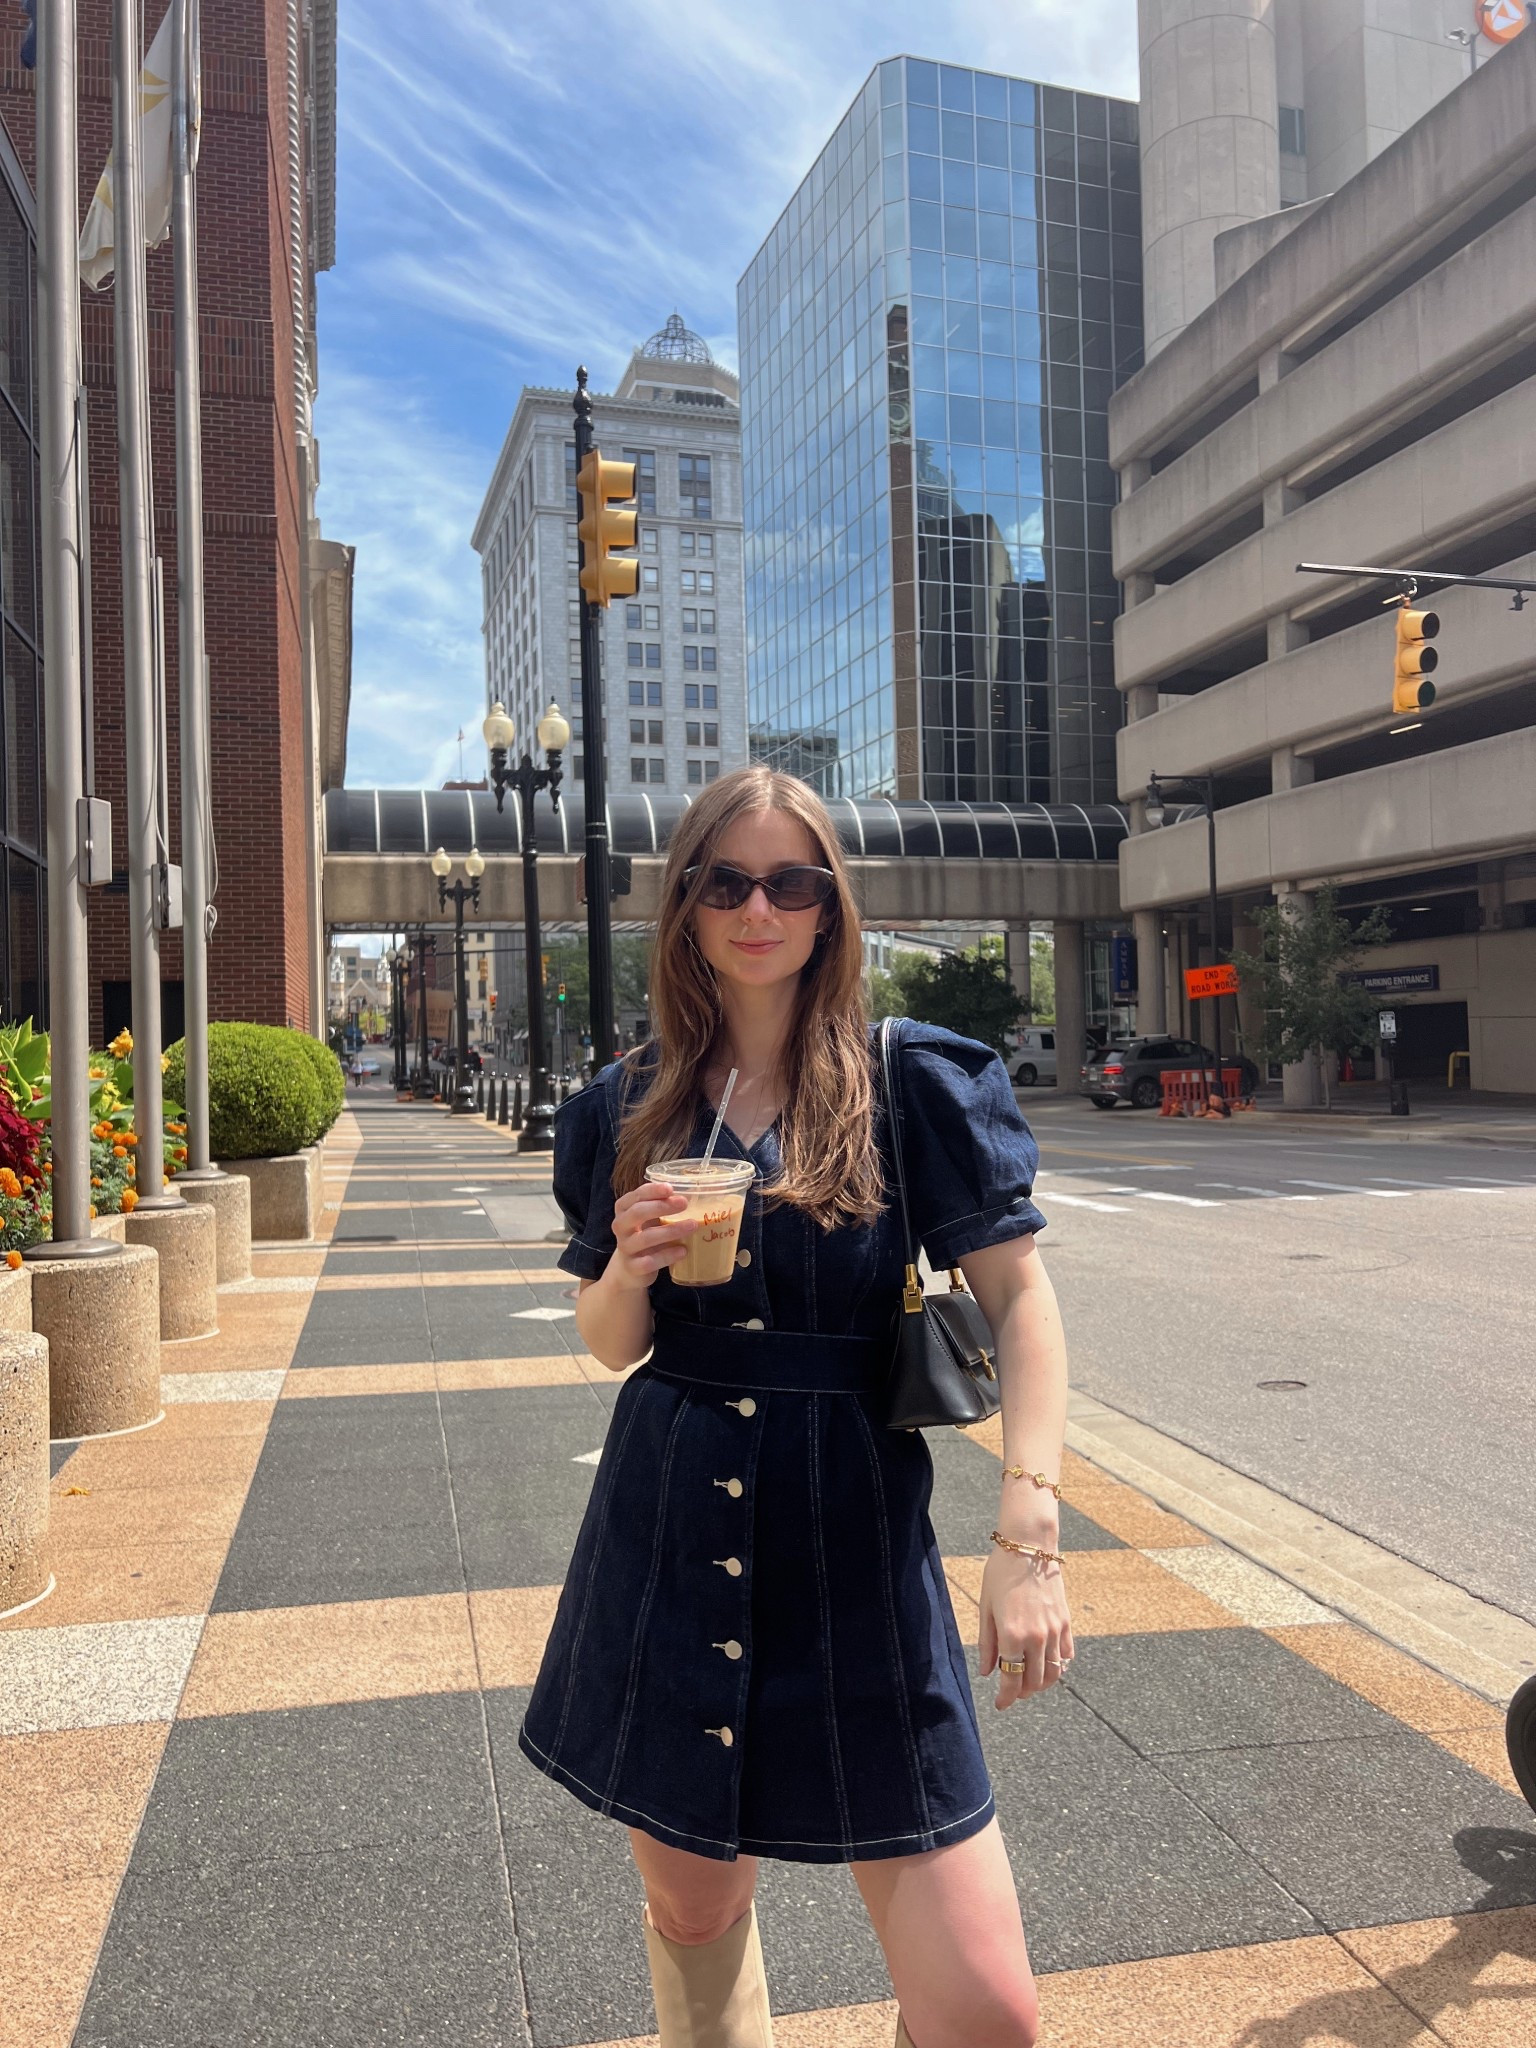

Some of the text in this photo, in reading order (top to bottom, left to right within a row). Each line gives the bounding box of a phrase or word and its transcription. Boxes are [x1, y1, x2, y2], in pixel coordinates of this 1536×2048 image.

[1204, 970, 1219, 980] END
[1364, 977, 1392, 988] PARKING
[1393, 973, 1430, 986] ENTRANCE
[1191, 984, 1211, 993] ROAD
[702, 1227, 735, 1242] Jacob
